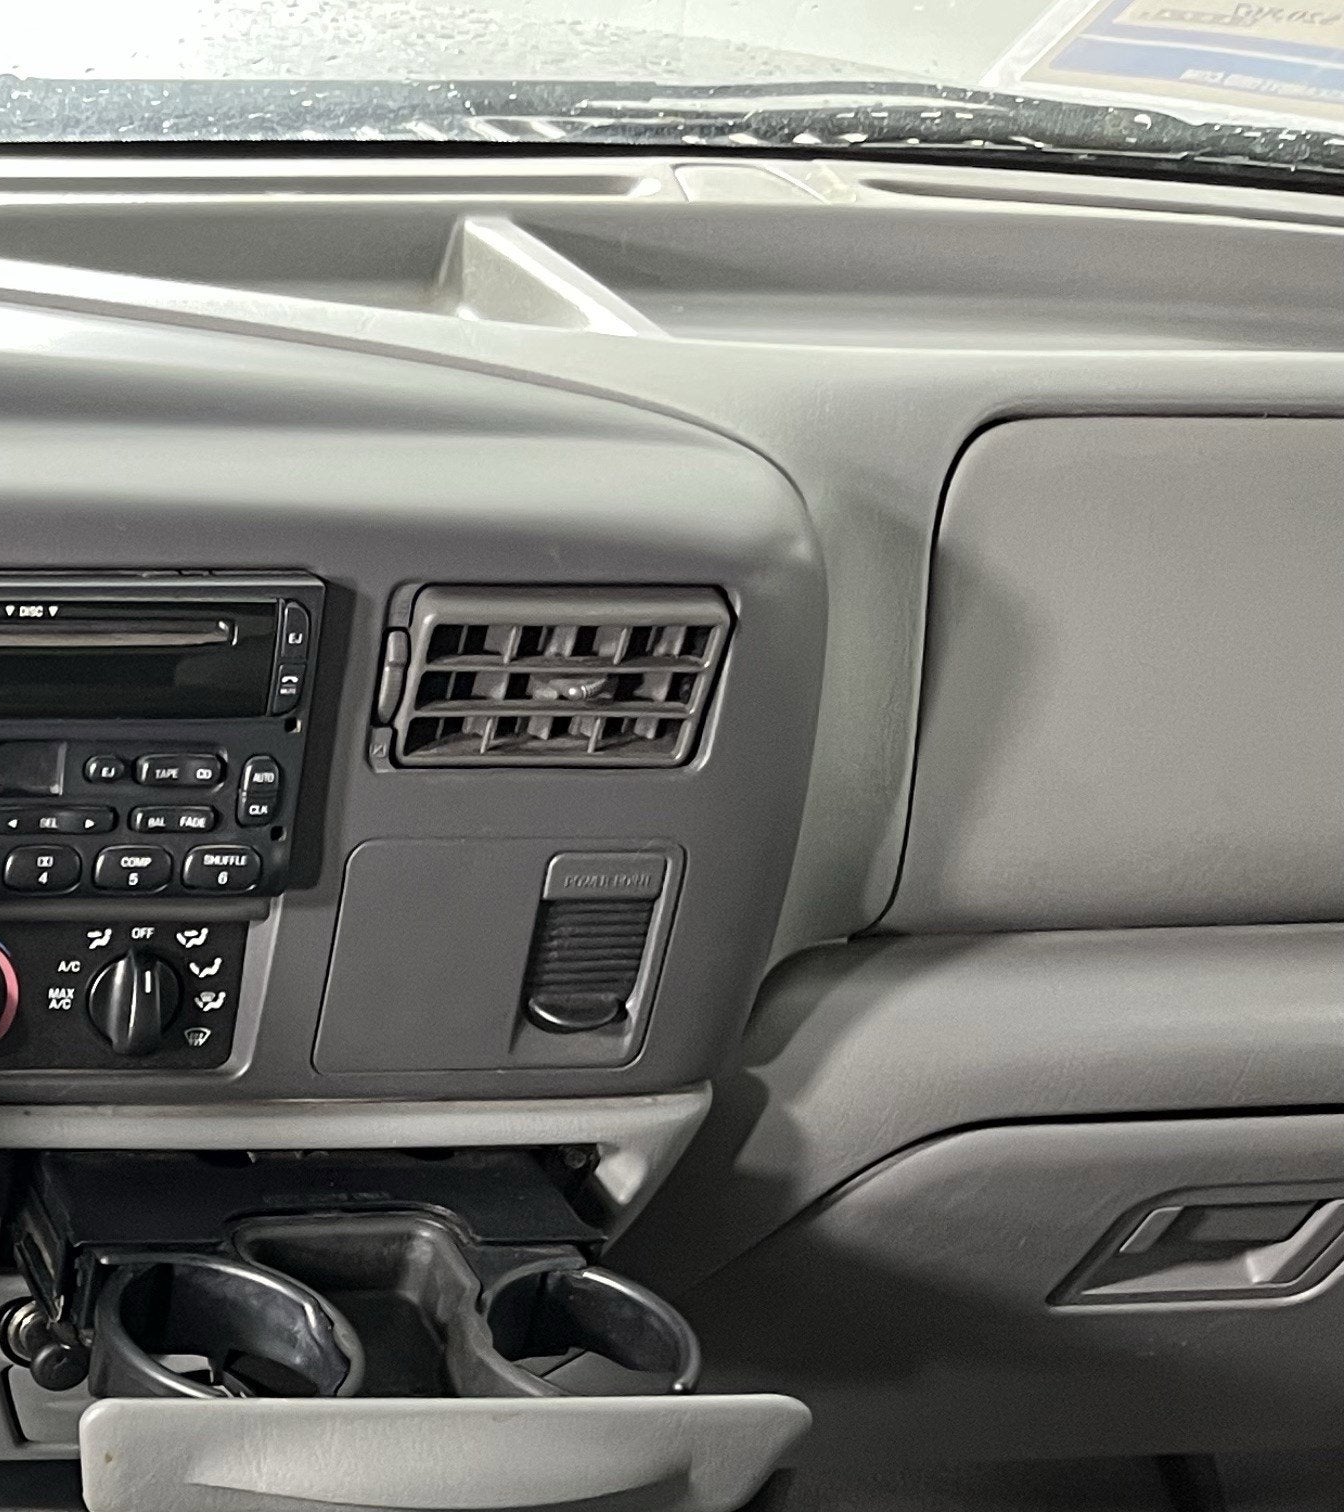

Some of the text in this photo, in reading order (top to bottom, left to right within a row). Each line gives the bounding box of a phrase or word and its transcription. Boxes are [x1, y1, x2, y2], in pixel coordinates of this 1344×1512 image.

[19, 606, 44, 617] DISC
[288, 633, 303, 644] EJ
[155, 768, 212, 779] TAPE CD
[253, 772, 275, 783] AUTO
[148, 816, 206, 828] BAL FADE
[120, 857, 152, 868] COMP
[38, 872, 48, 884] 4
[128, 872, 139, 885] 5
[217, 871, 228, 884] 6
[131, 927, 155, 939] OFF
[58, 961, 81, 972] A/C
[48, 988, 75, 999] MAX
[48, 999, 72, 1010] A/C
